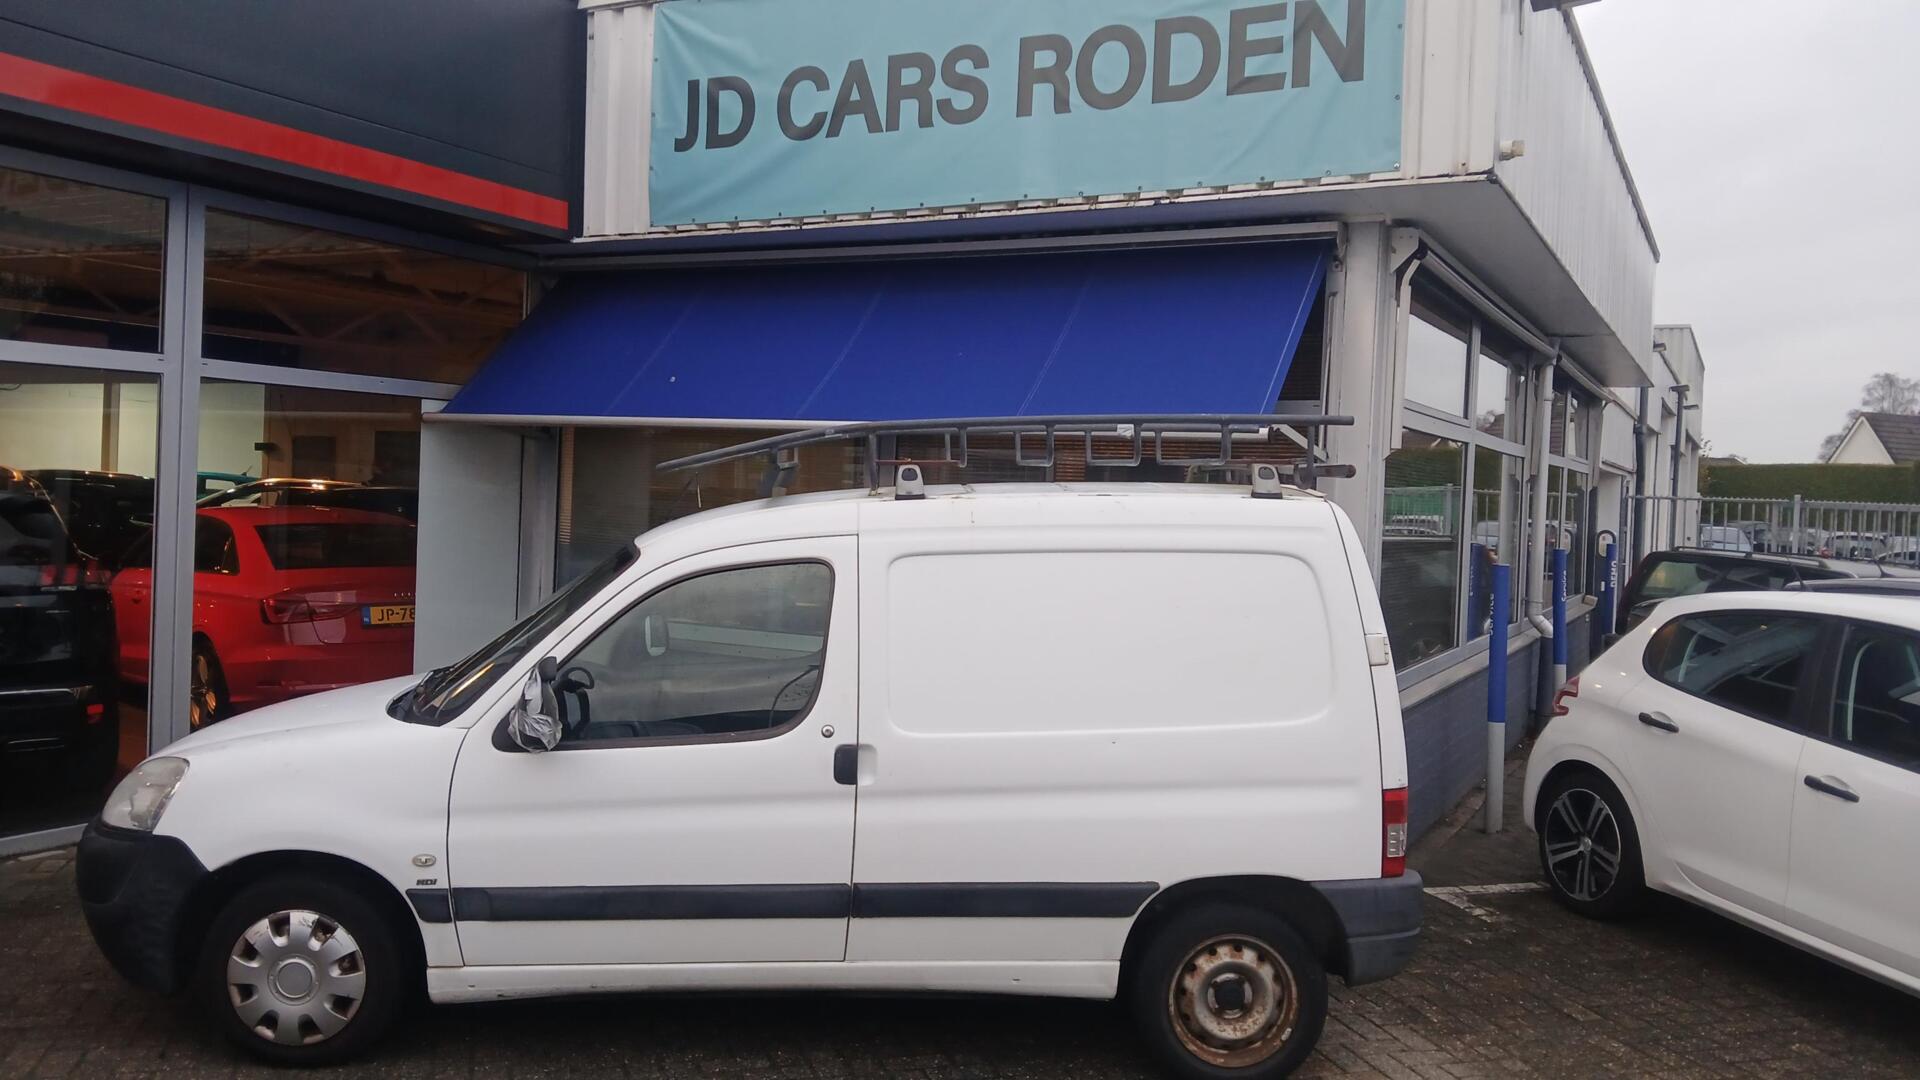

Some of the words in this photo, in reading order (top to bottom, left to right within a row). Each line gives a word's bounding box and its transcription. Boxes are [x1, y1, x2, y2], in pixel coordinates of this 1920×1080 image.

[673, 75, 755, 152] JD
[777, 43, 990, 140] CARS
[1015, 0, 1367, 118] RODEN
